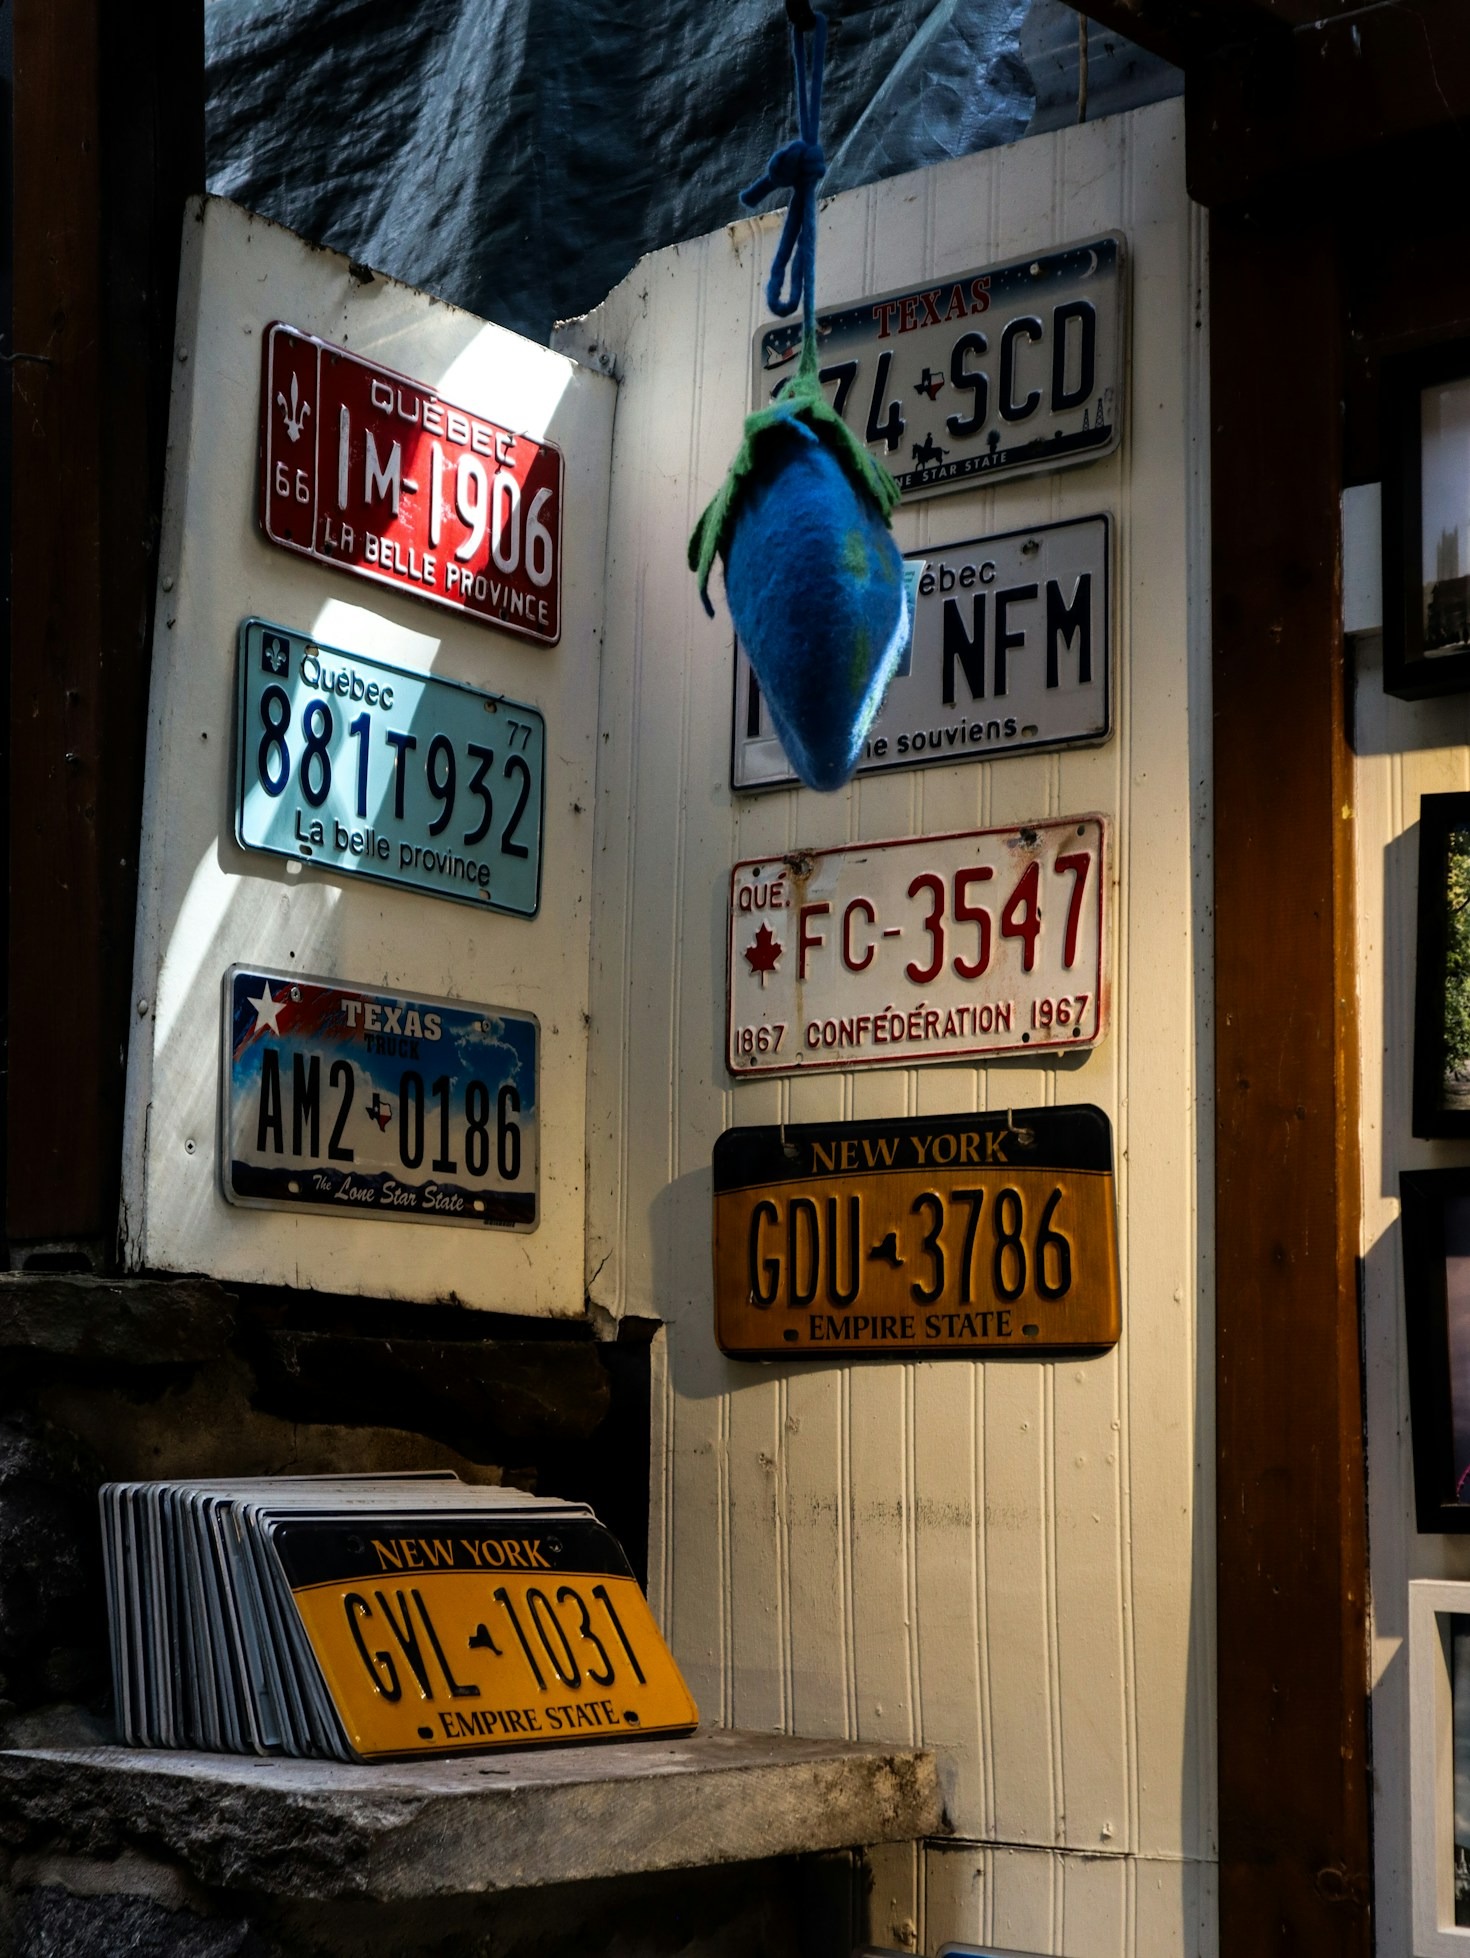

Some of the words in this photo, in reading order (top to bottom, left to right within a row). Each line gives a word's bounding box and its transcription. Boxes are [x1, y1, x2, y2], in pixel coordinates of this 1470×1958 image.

[872, 276, 991, 339] TEXAS
[769, 350, 906, 452] 74
[946, 300, 1096, 437] SCD
[371, 378, 517, 468] QUÉBEC
[276, 461, 310, 505] 66
[338, 403, 553, 587] 1M-1906
[922, 464, 957, 482] STAR
[965, 452, 1008, 471] STATE
[325, 517, 354, 553] LA
[365, 531, 437, 584] BELLE
[446, 562, 549, 625] PROVINCE
[918, 561, 997, 596] ébec
[942, 573, 1092, 705] NFM
[300, 654, 394, 710] Québec
[507, 719, 533, 750] 77
[897, 716, 1018, 754] souviens
[258, 684, 532, 859] 881T932
[295, 808, 324, 846] La
[334, 818, 390, 860] belle
[400, 842, 490, 886] province
[797, 852, 1091, 984] FC-3547
[341, 999, 442, 1041] TEXAS
[363, 1033, 420, 1060] TRUCK
[736, 1025, 785, 1053] 1867
[807, 1002, 1012, 1048] CONFÉDÉRATION
[1032, 995, 1089, 1029] 1967
[257, 1048, 355, 1163] AM2
[399, 1070, 521, 1180] 0186
[812, 1138, 899, 1173] NEW
[911, 1131, 1008, 1164] YORK
[313, 1174, 331, 1191] The
[334, 1176, 374, 1201] Lone
[380, 1181, 417, 1206] Star
[422, 1185, 464, 1211] State
[750, 1195, 860, 1305] GDU
[912, 1188, 1072, 1303] 3786
[809, 1315, 915, 1341] EMPIRE
[925, 1310, 1012, 1338] STATE
[371, 1539, 455, 1569] NEW
[461, 1539, 551, 1567] YORK
[344, 1589, 480, 1703] GVL
[495, 1584, 646, 1690] 1031
[438, 1708, 542, 1739] EMPIRE
[542, 1700, 620, 1728] STATE
